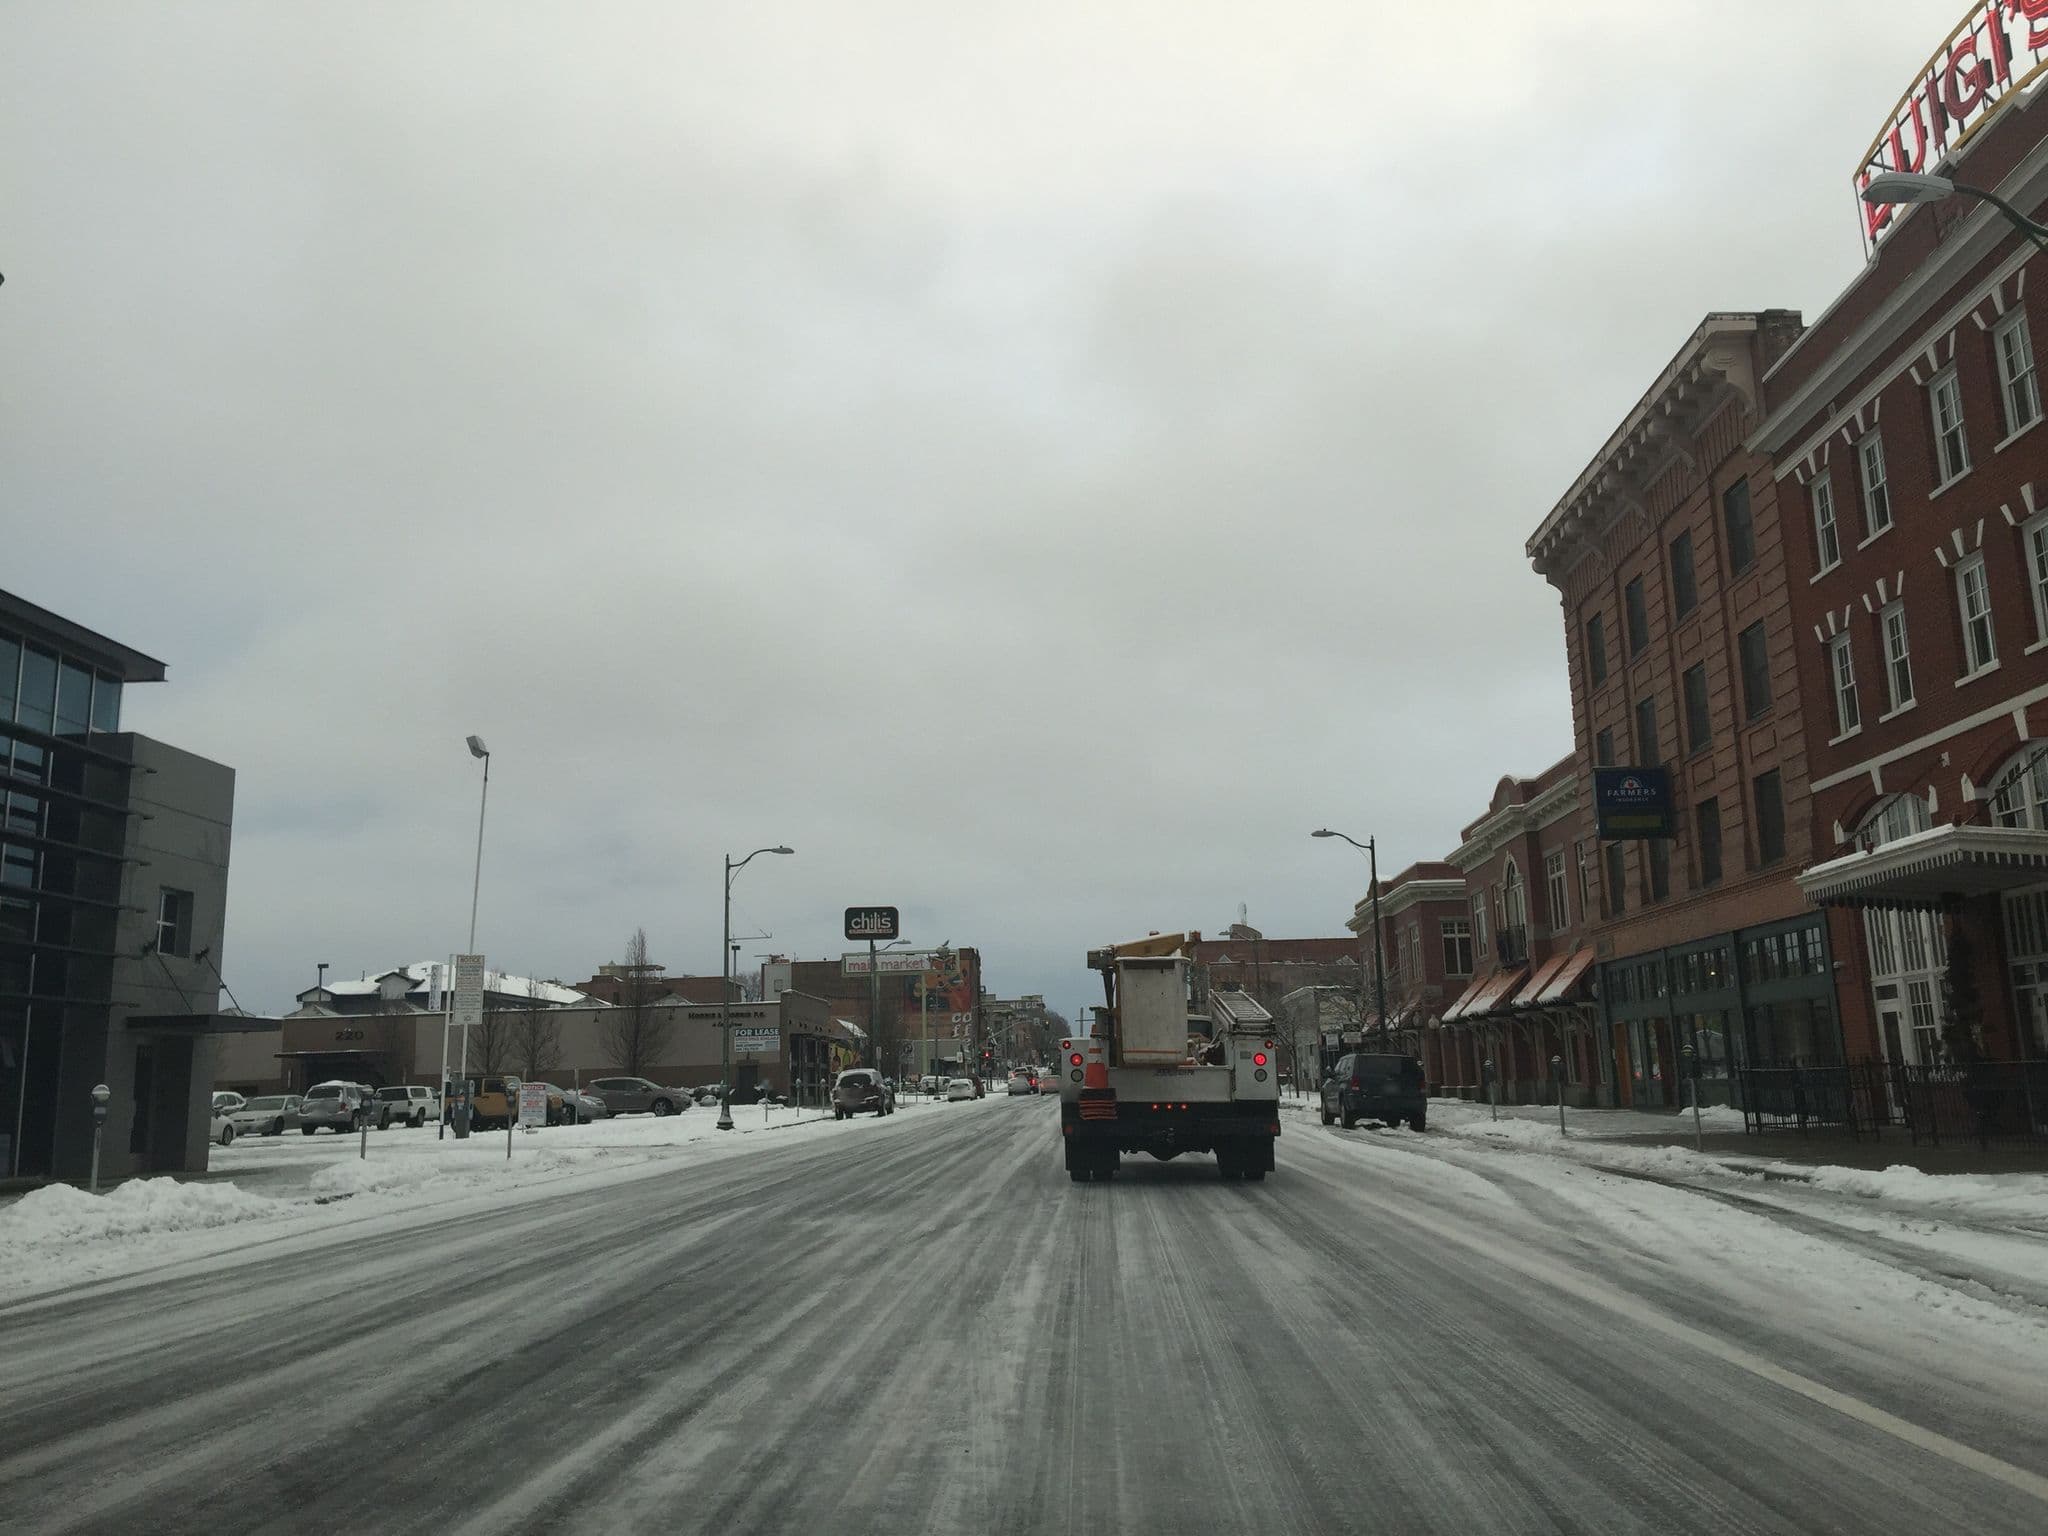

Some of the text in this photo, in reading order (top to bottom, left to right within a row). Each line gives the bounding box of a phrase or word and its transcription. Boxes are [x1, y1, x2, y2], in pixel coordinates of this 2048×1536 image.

[1607, 788, 1657, 797] FARMERS
[881, 957, 925, 970] market
[335, 1031, 365, 1040] 220
